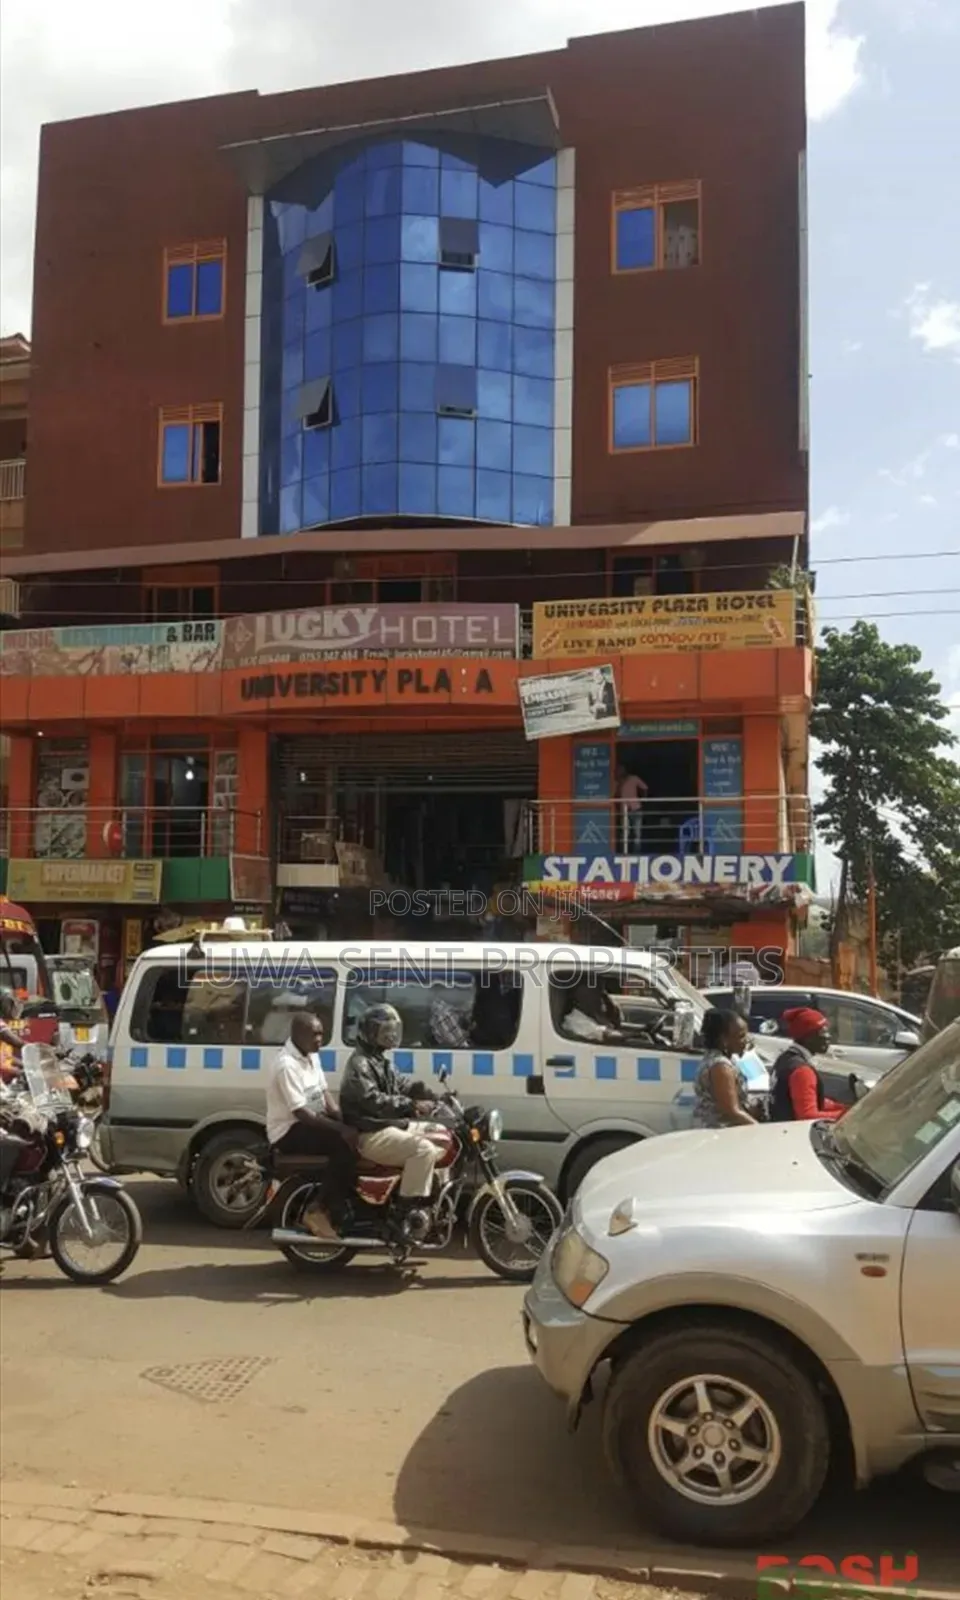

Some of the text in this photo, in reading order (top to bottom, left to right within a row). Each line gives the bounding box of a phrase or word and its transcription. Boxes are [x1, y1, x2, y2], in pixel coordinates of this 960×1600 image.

[544, 594, 776, 618] UNIVERSITY PLAZA HOTEL
[182, 623, 216, 642] BAR
[255, 608, 378, 648] LUCKY
[380, 616, 514, 644] HOTEL
[241, 669, 388, 700] UNIVERSITY
[543, 855, 794, 884] STATIONERY
